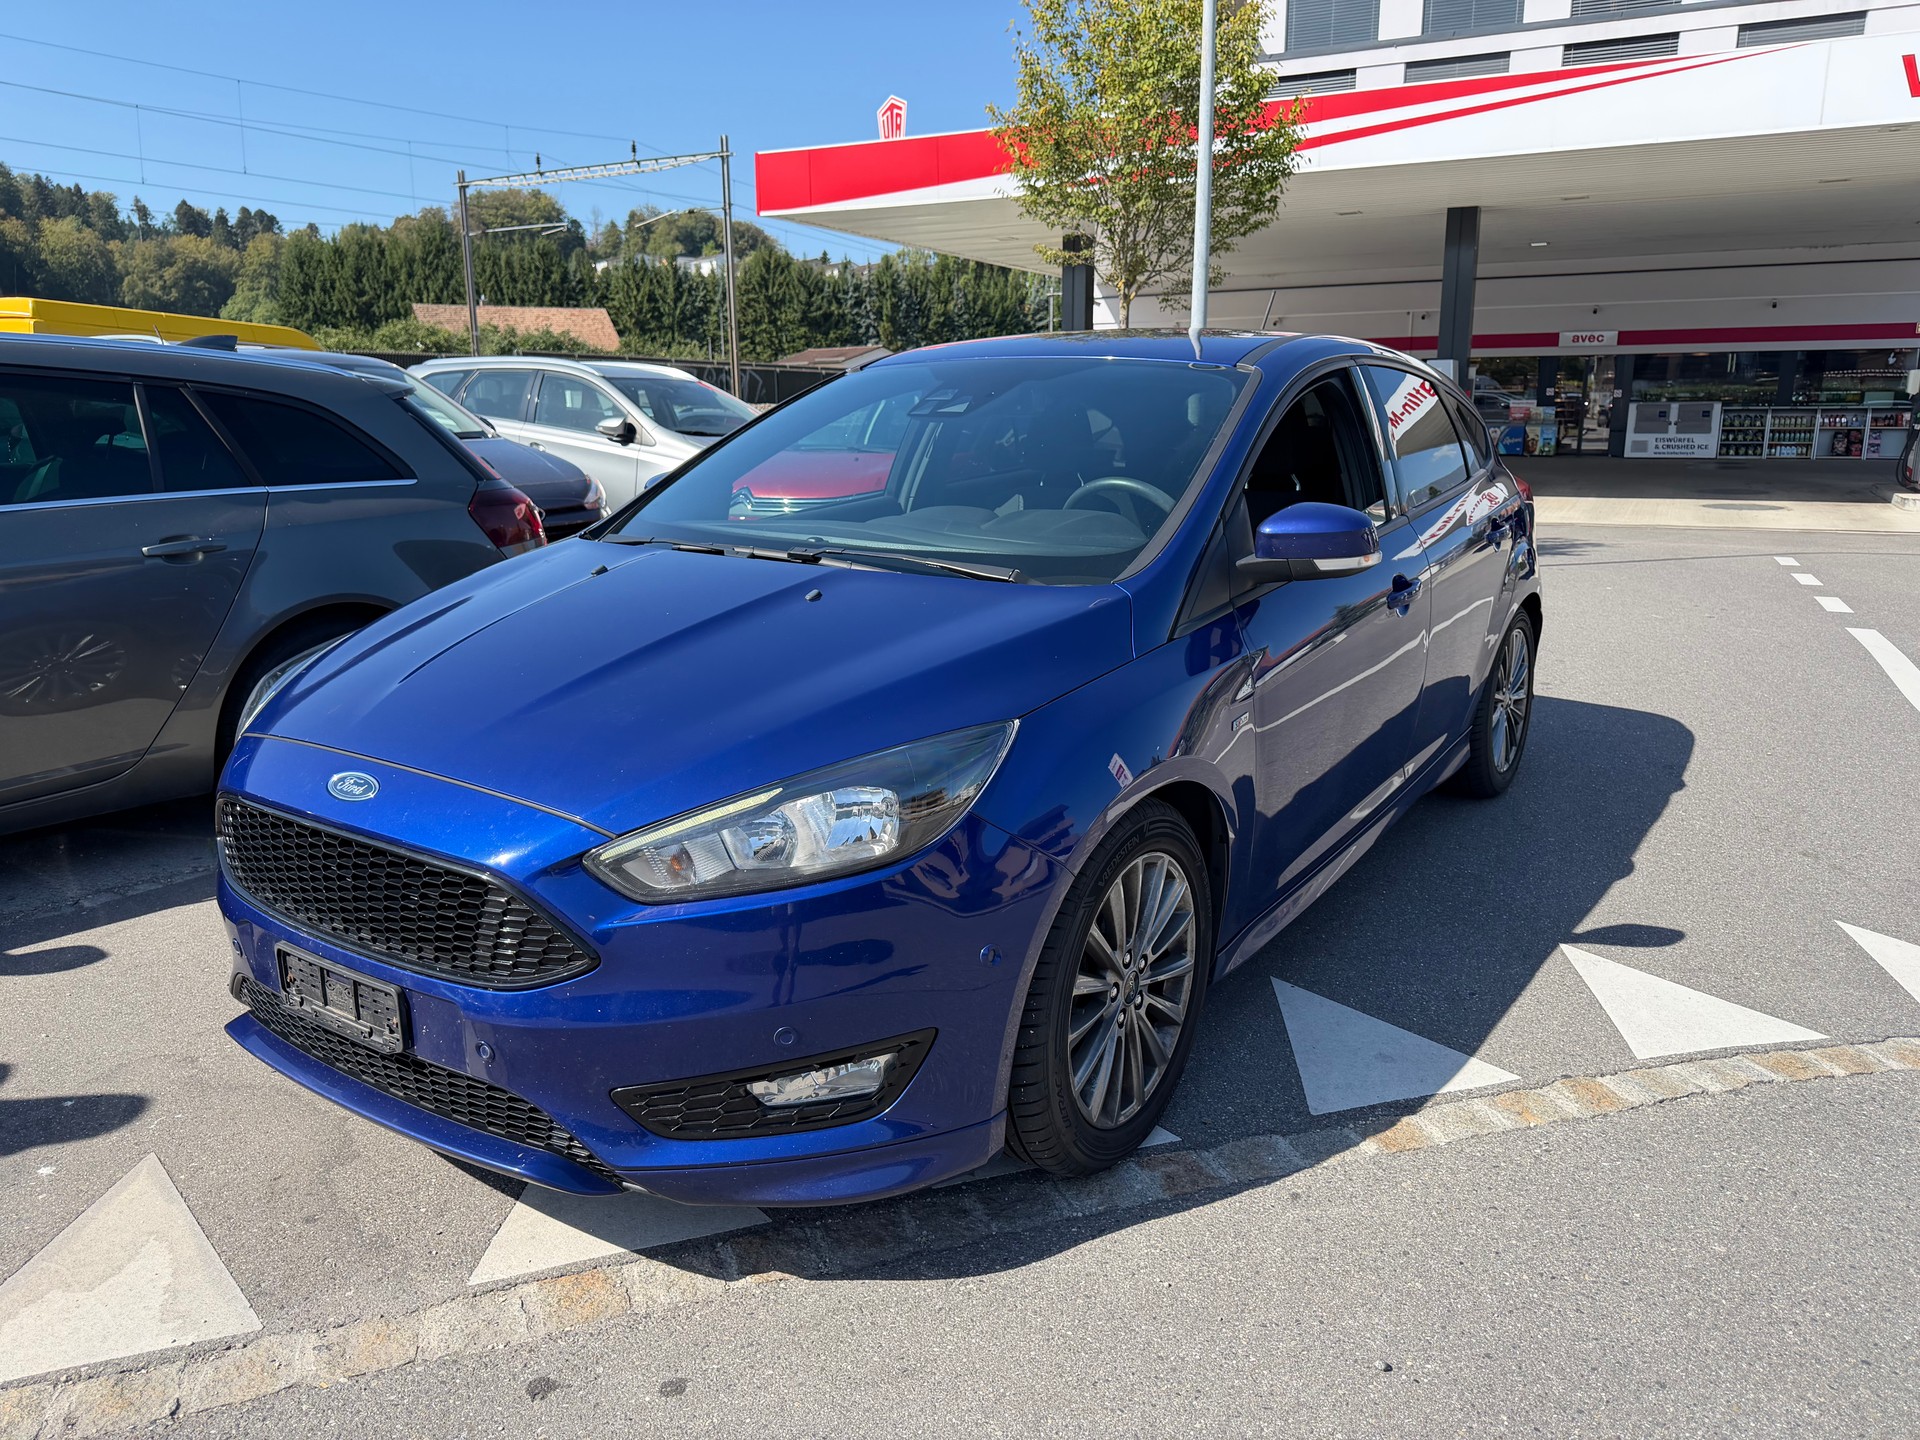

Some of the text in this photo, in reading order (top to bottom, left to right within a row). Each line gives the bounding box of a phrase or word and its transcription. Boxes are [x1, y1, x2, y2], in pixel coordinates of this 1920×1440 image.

[1571, 333, 1605, 343] avec
[336, 776, 368, 795] Ford
[1098, 833, 1141, 888] VREDESTEIN
[1054, 1077, 1072, 1129] ULTRAC
